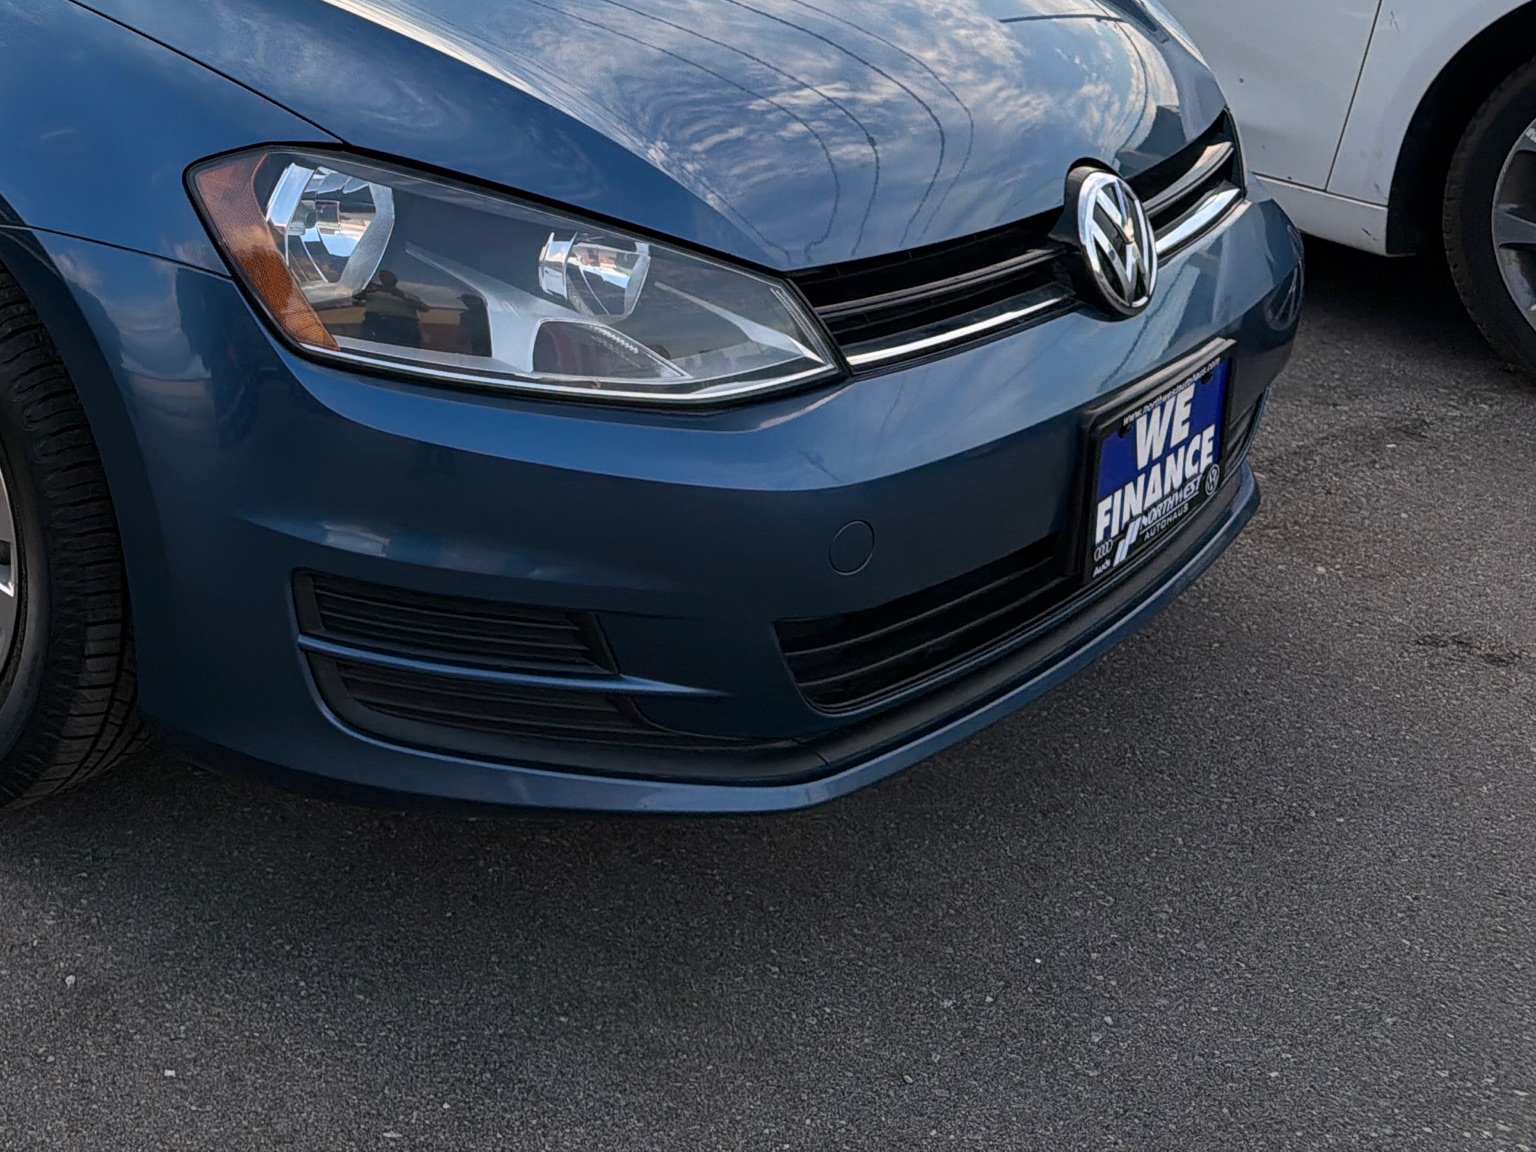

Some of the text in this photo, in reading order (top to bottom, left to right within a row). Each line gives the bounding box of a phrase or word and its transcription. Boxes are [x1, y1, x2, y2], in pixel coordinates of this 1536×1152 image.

[1078, 172, 1158, 307] VW
[1135, 383, 1196, 471] WE
[1095, 424, 1216, 547] FINANCE
[1139, 473, 1204, 531] NORTHWEST
[1143, 503, 1189, 542] AUTOHAUS
[1092, 558, 1112, 578] Audi
